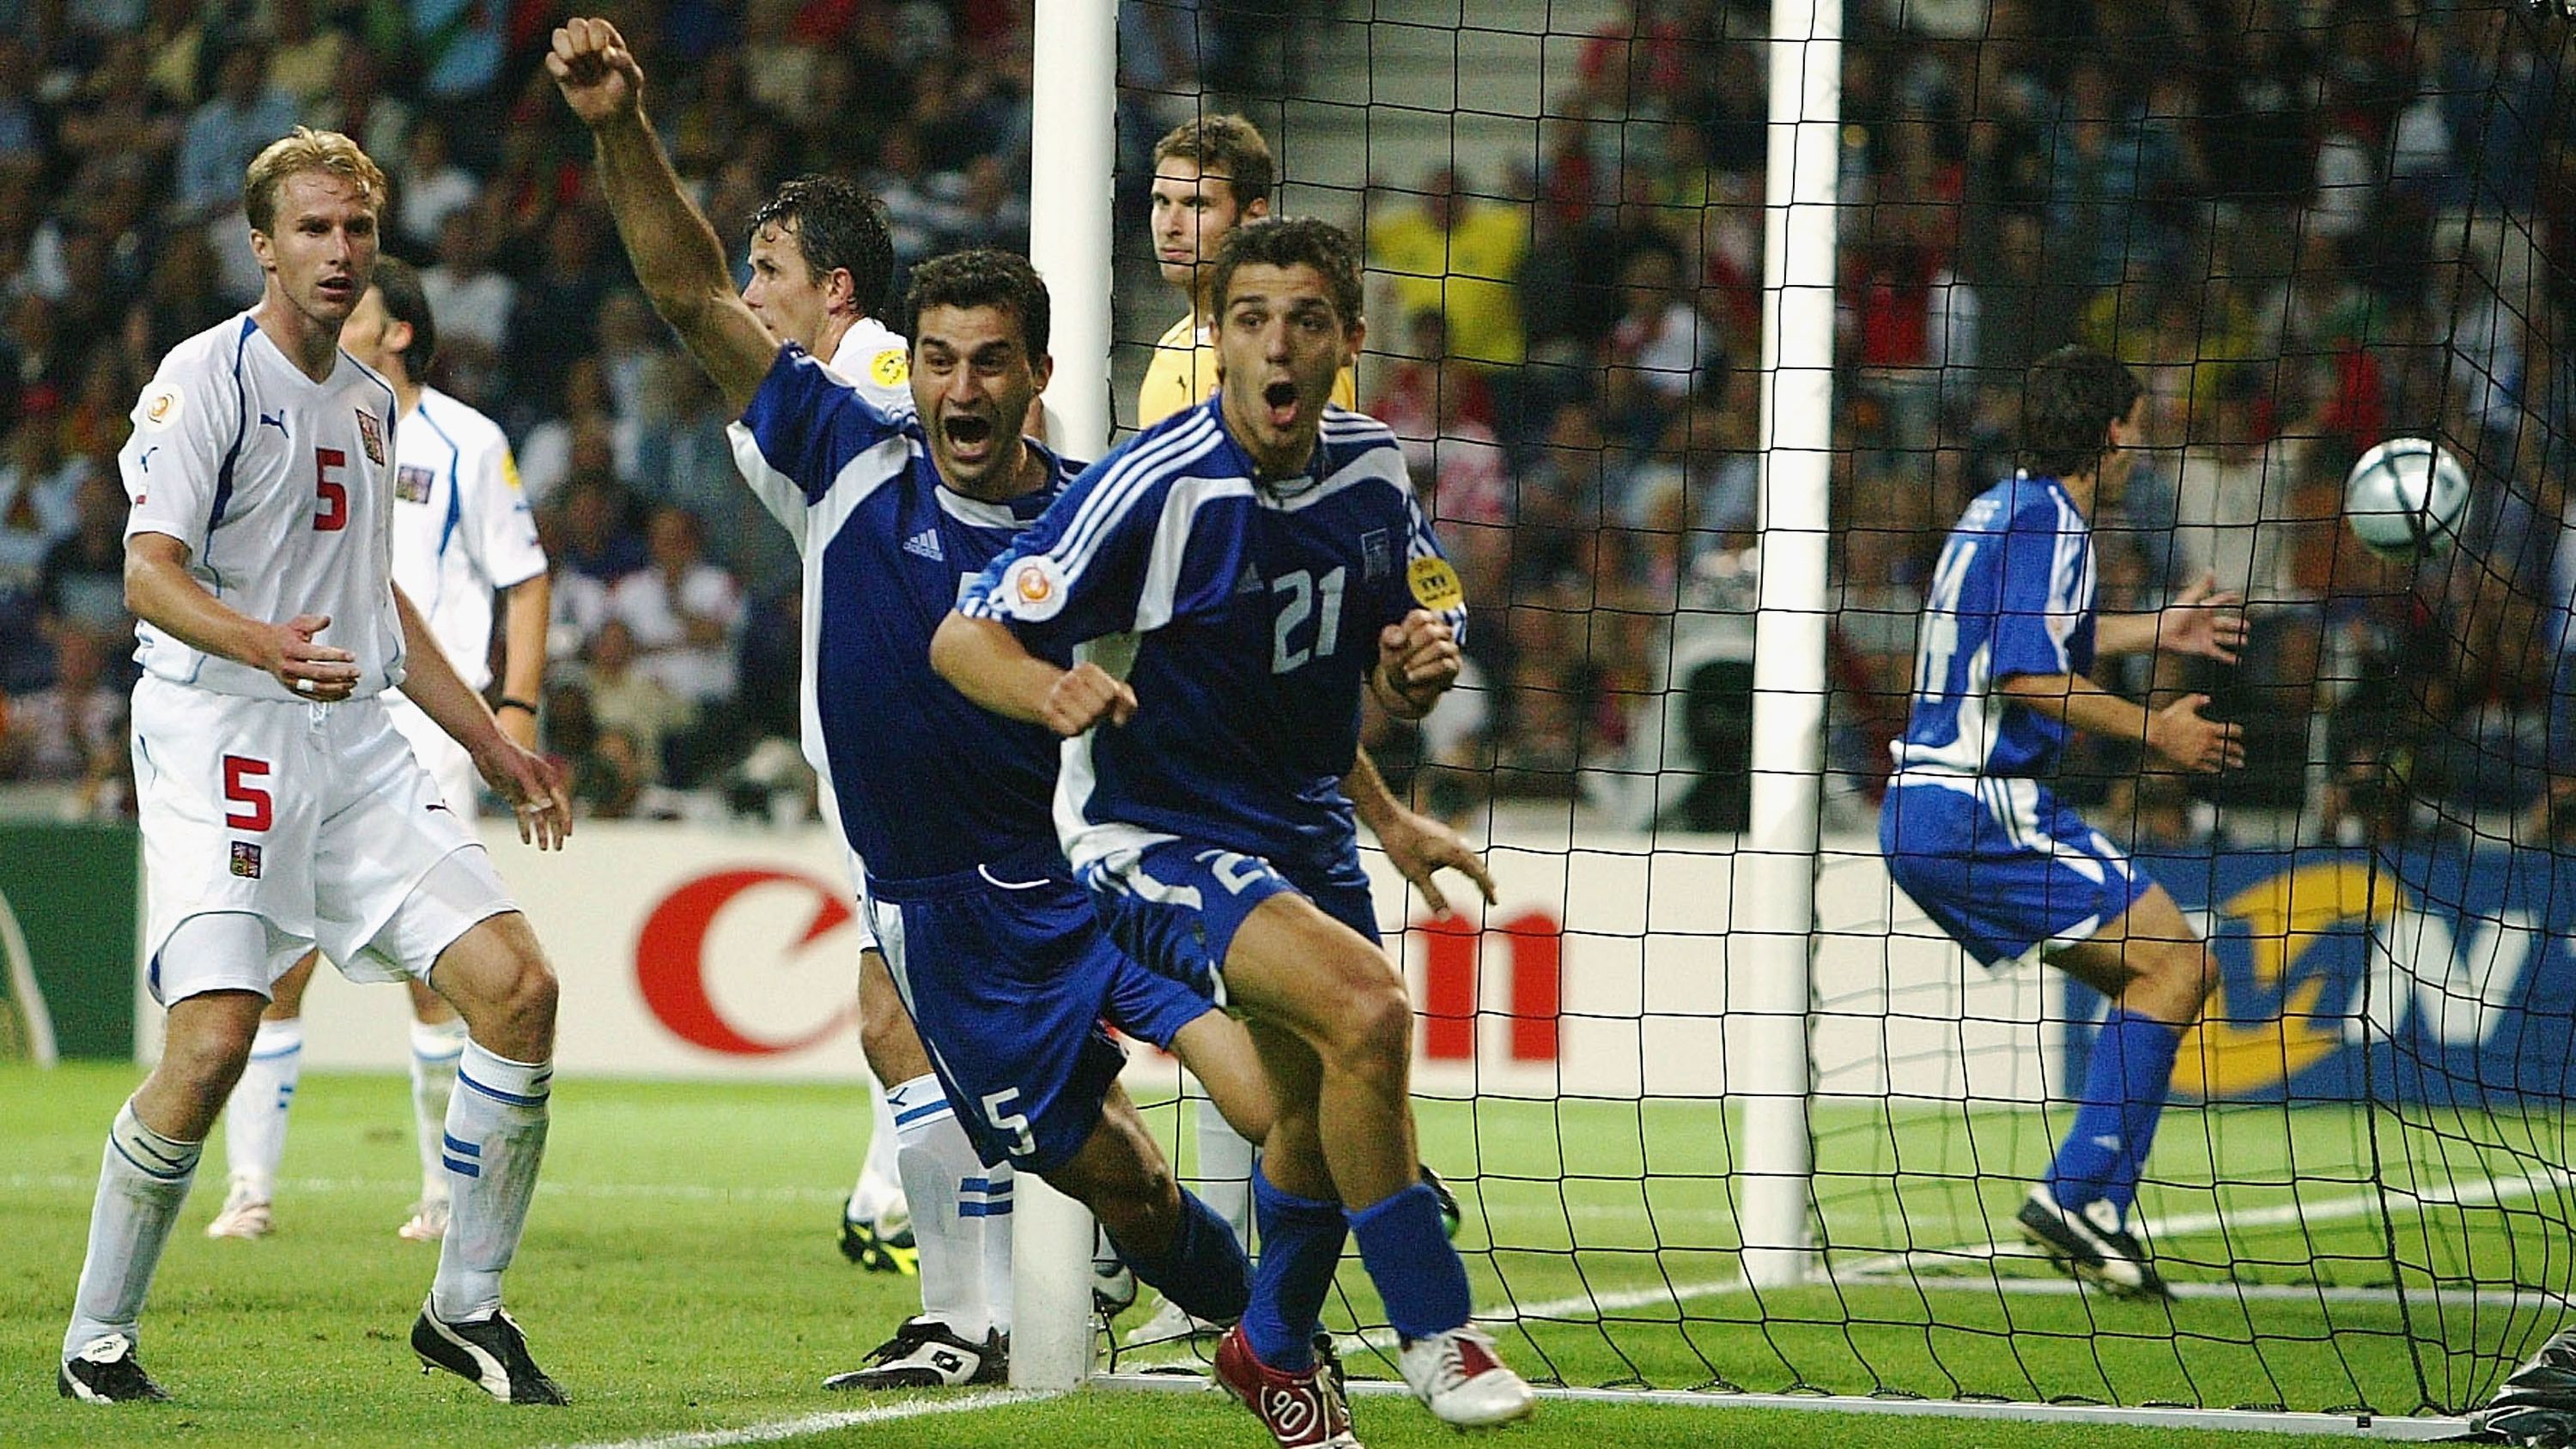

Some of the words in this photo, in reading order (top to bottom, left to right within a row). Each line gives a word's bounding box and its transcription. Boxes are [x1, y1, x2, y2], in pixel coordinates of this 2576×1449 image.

[313, 447, 347, 531] 5
[1272, 566, 1346, 674] 21
[223, 755, 272, 833] 5
[981, 1087, 1036, 1156] 5
[1271, 1390, 1308, 1430] 90
